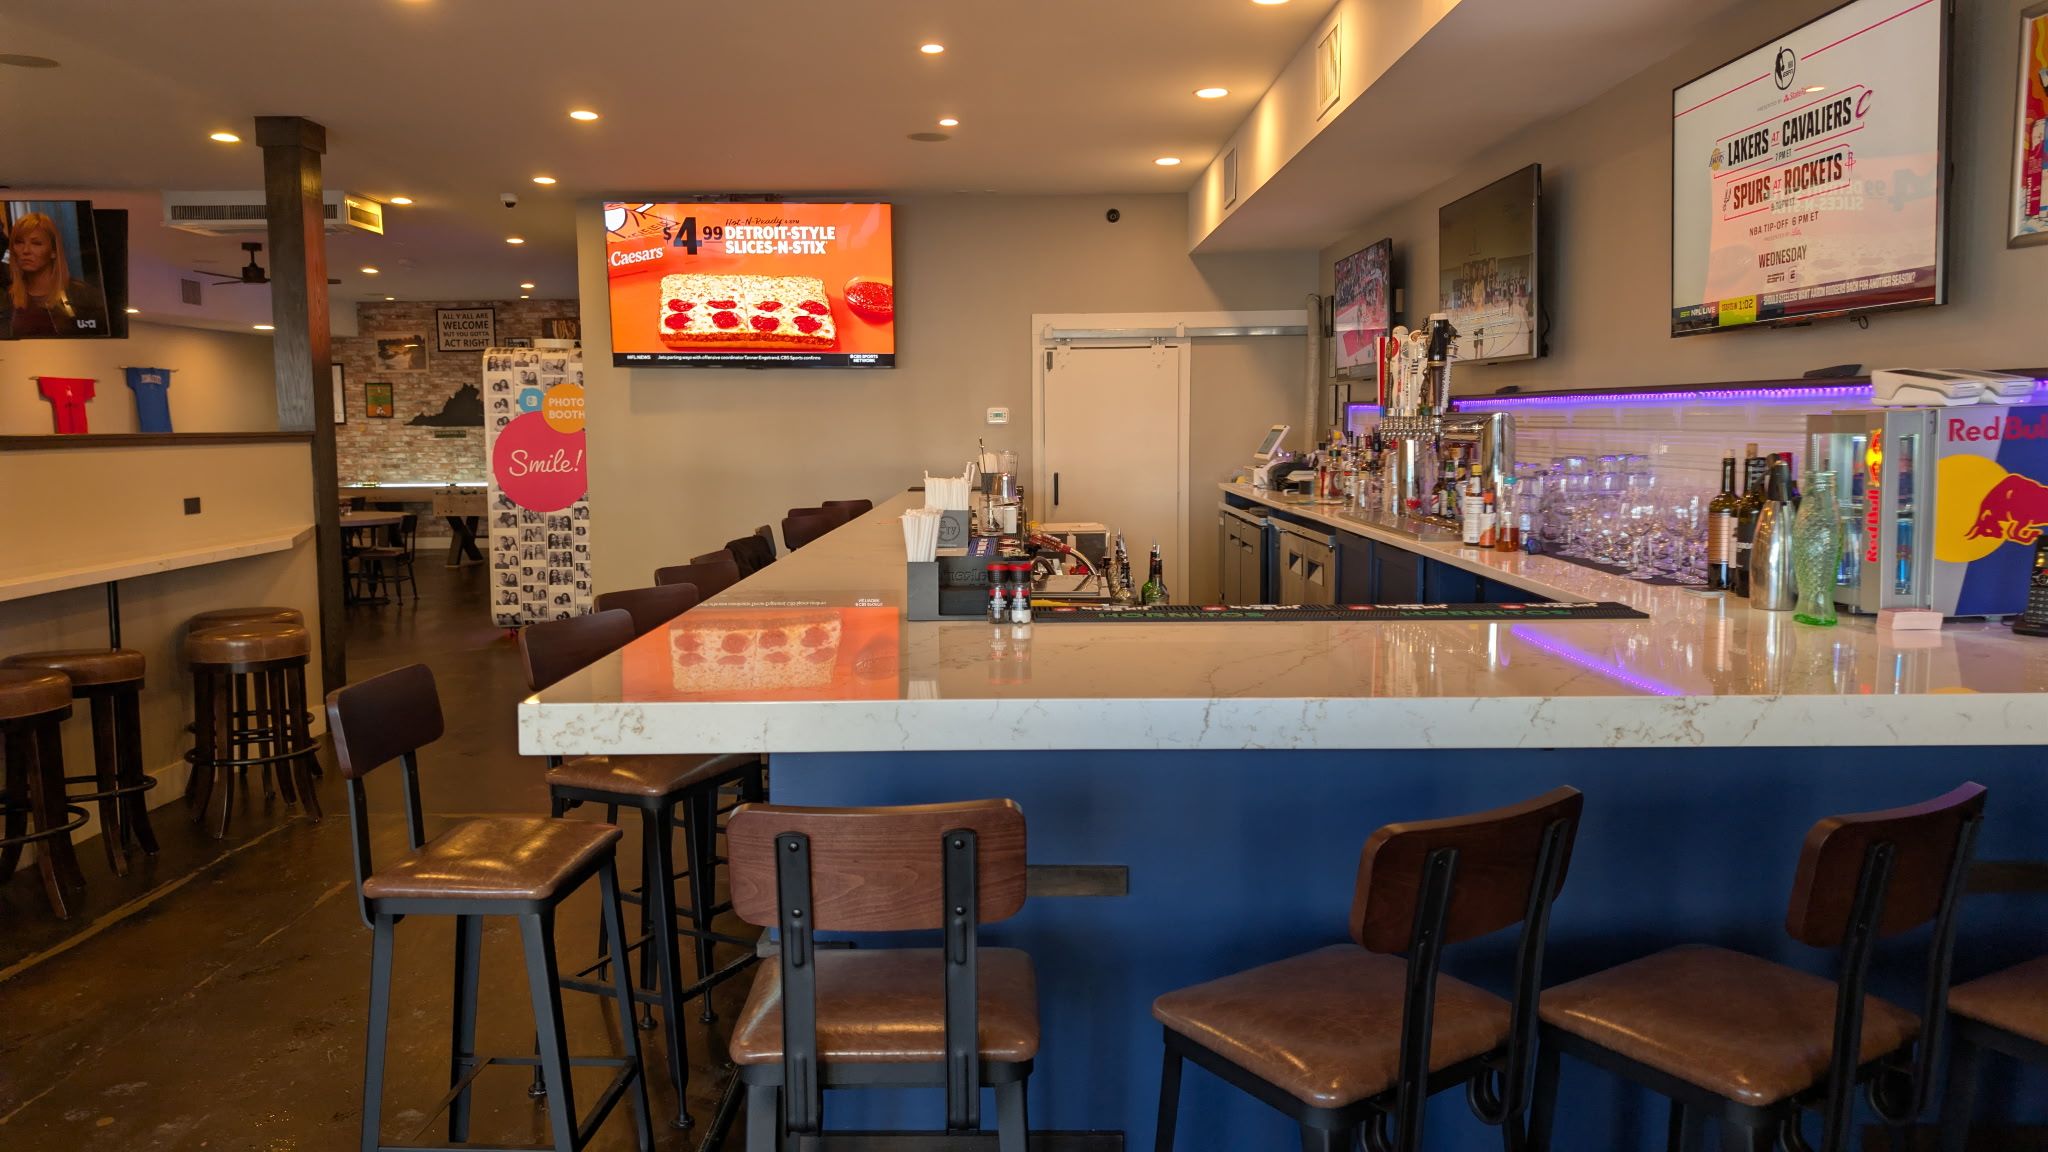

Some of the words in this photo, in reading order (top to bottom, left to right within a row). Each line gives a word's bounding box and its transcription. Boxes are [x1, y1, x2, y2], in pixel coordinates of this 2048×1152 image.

[1728, 128, 1769, 166] LAKERS
[1771, 130, 1780, 143] AT
[1782, 97, 1852, 146] CAVALIERS
[1733, 176, 1771, 209] SPURS
[1773, 179, 1782, 190] AT
[1784, 153, 1843, 195] ROCKETS
[725, 226, 835, 240] DETROIT-STYLE
[1749, 226, 1762, 236] NBA
[1764, 220, 1789, 233] TIP-OFF
[1791, 217, 1797, 226] 6
[1798, 213, 1808, 224] PM
[1810, 211, 1819, 221] ET
[611, 247, 664, 267] Caesars
[725, 241, 827, 255] SLICES-N-STIX
[1758, 245, 1807, 269] WEDNESDAY
[1766, 272, 1784, 284] ESPN
[1860, 279, 1870, 291] FOR
[1870, 276, 1892, 290] ANOTHER
[1892, 272, 1917, 287] SEASON?
[1702, 306, 1716, 315] LIVE
[1739, 298, 1753, 310] 1:02
[443, 320, 489, 330] WELCOME
[445, 339, 460, 348] ACT
[463, 339, 489, 348] RIGHT
[549, 397, 585, 407] PHOTO
[549, 410, 585, 419] BOOTH
[1948, 415, 2000, 442] Red
[2005, 415, 2048, 440] Bul
[509, 448, 583, 477] Smile!
[1866, 489, 1880, 525] Bull
[1865, 526, 1879, 563] Red
